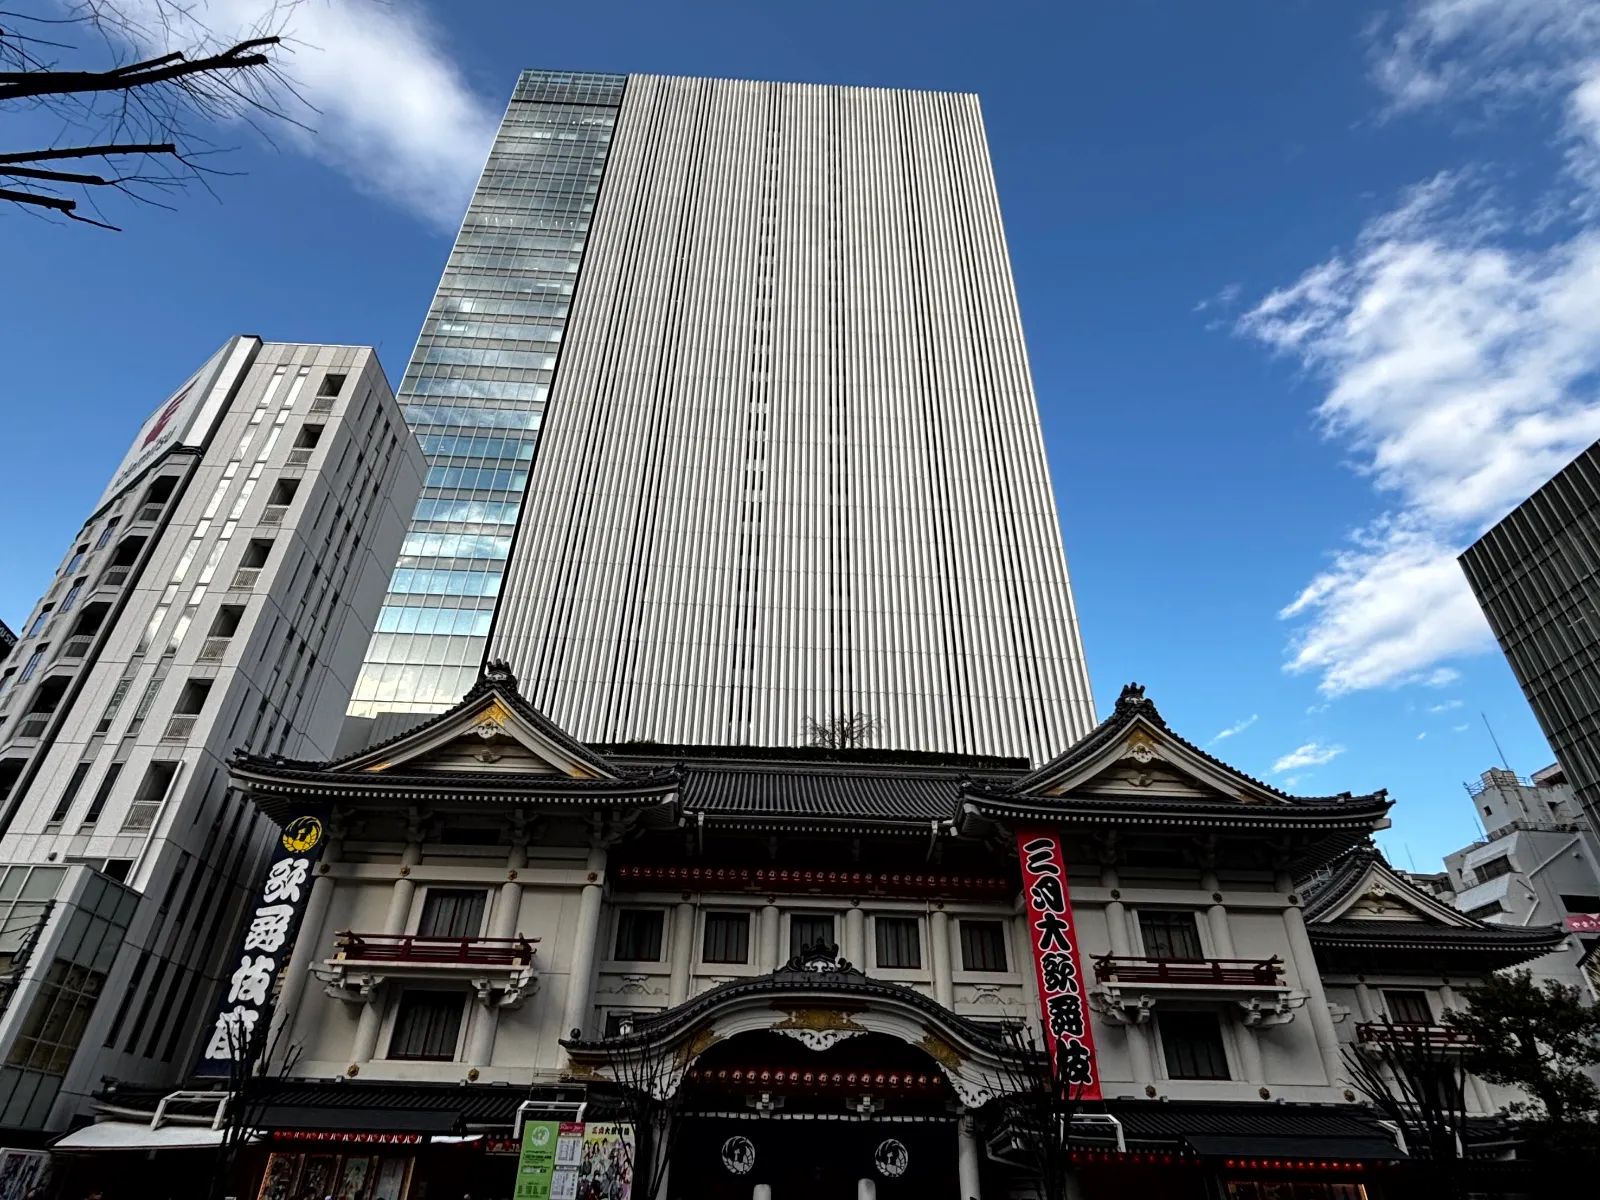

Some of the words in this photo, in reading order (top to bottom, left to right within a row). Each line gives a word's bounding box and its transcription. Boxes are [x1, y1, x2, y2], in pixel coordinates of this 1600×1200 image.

[205, 858, 309, 1061] 歌舞伎座
[1023, 838, 1093, 1085] 三月大歌舞伎
